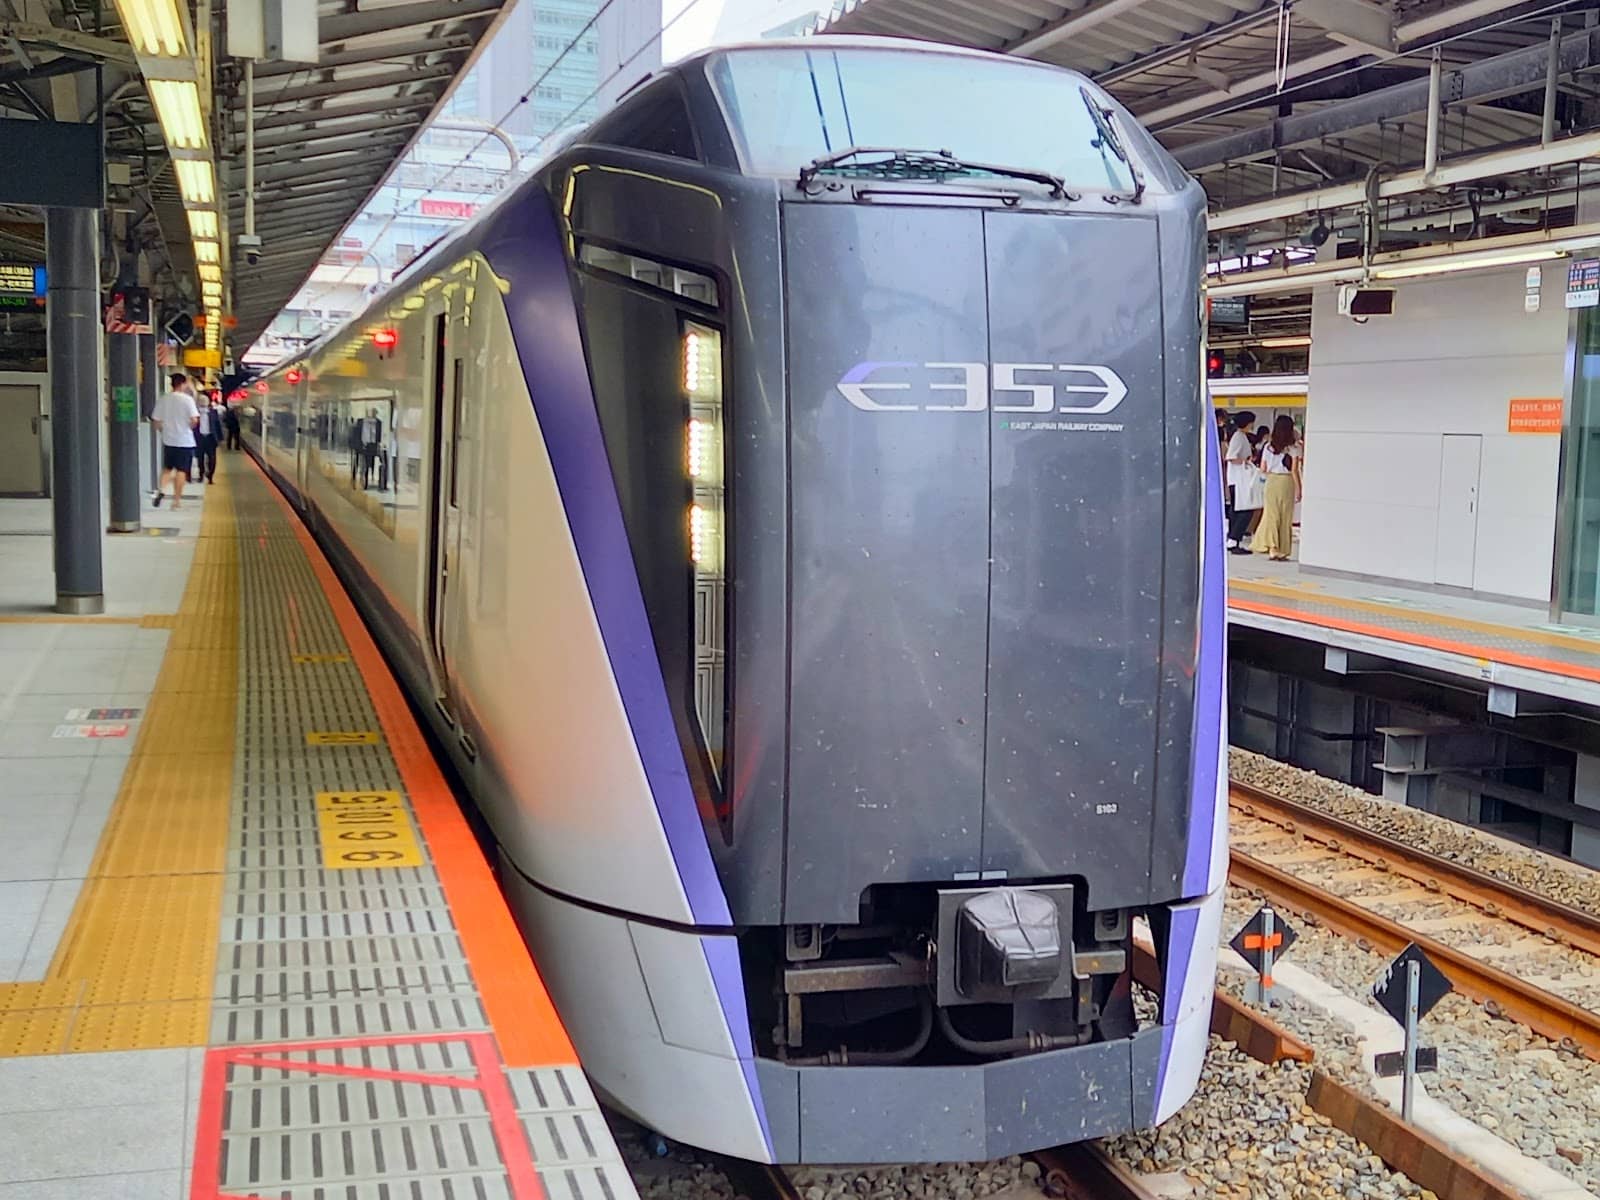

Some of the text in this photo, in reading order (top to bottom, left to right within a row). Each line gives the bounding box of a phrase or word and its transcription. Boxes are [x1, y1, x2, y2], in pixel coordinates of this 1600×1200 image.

[837, 361, 1128, 414] E353
[1010, 422, 1032, 430] EAST
[1032, 422, 1057, 430] JAPAN
[1057, 422, 1088, 431] RAILWAY
[1088, 423, 1124, 432] COMPANY
